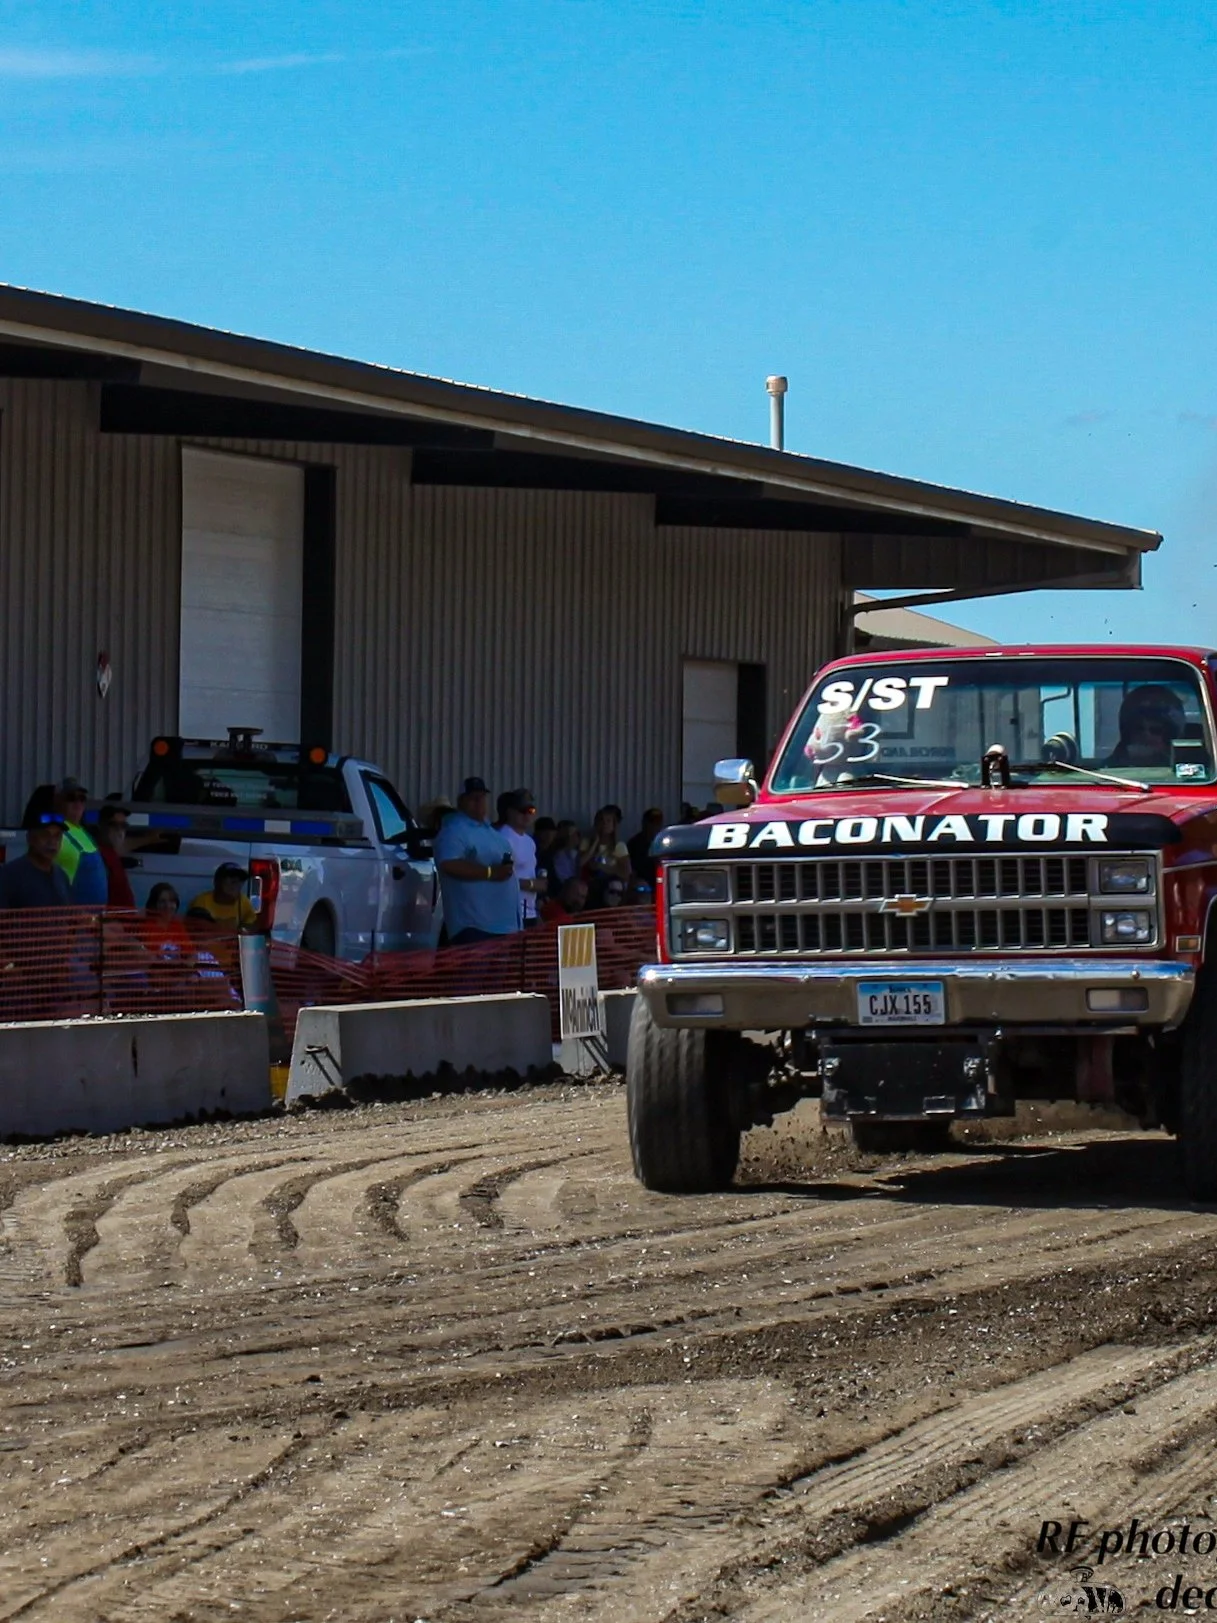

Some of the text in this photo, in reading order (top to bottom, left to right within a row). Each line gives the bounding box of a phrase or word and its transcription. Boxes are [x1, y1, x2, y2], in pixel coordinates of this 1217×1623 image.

[817, 676, 949, 714] S/ST
[813, 723, 881, 764] 53
[707, 813, 1109, 850] BACONATOR
[869, 994, 932, 1015] CJX 155
